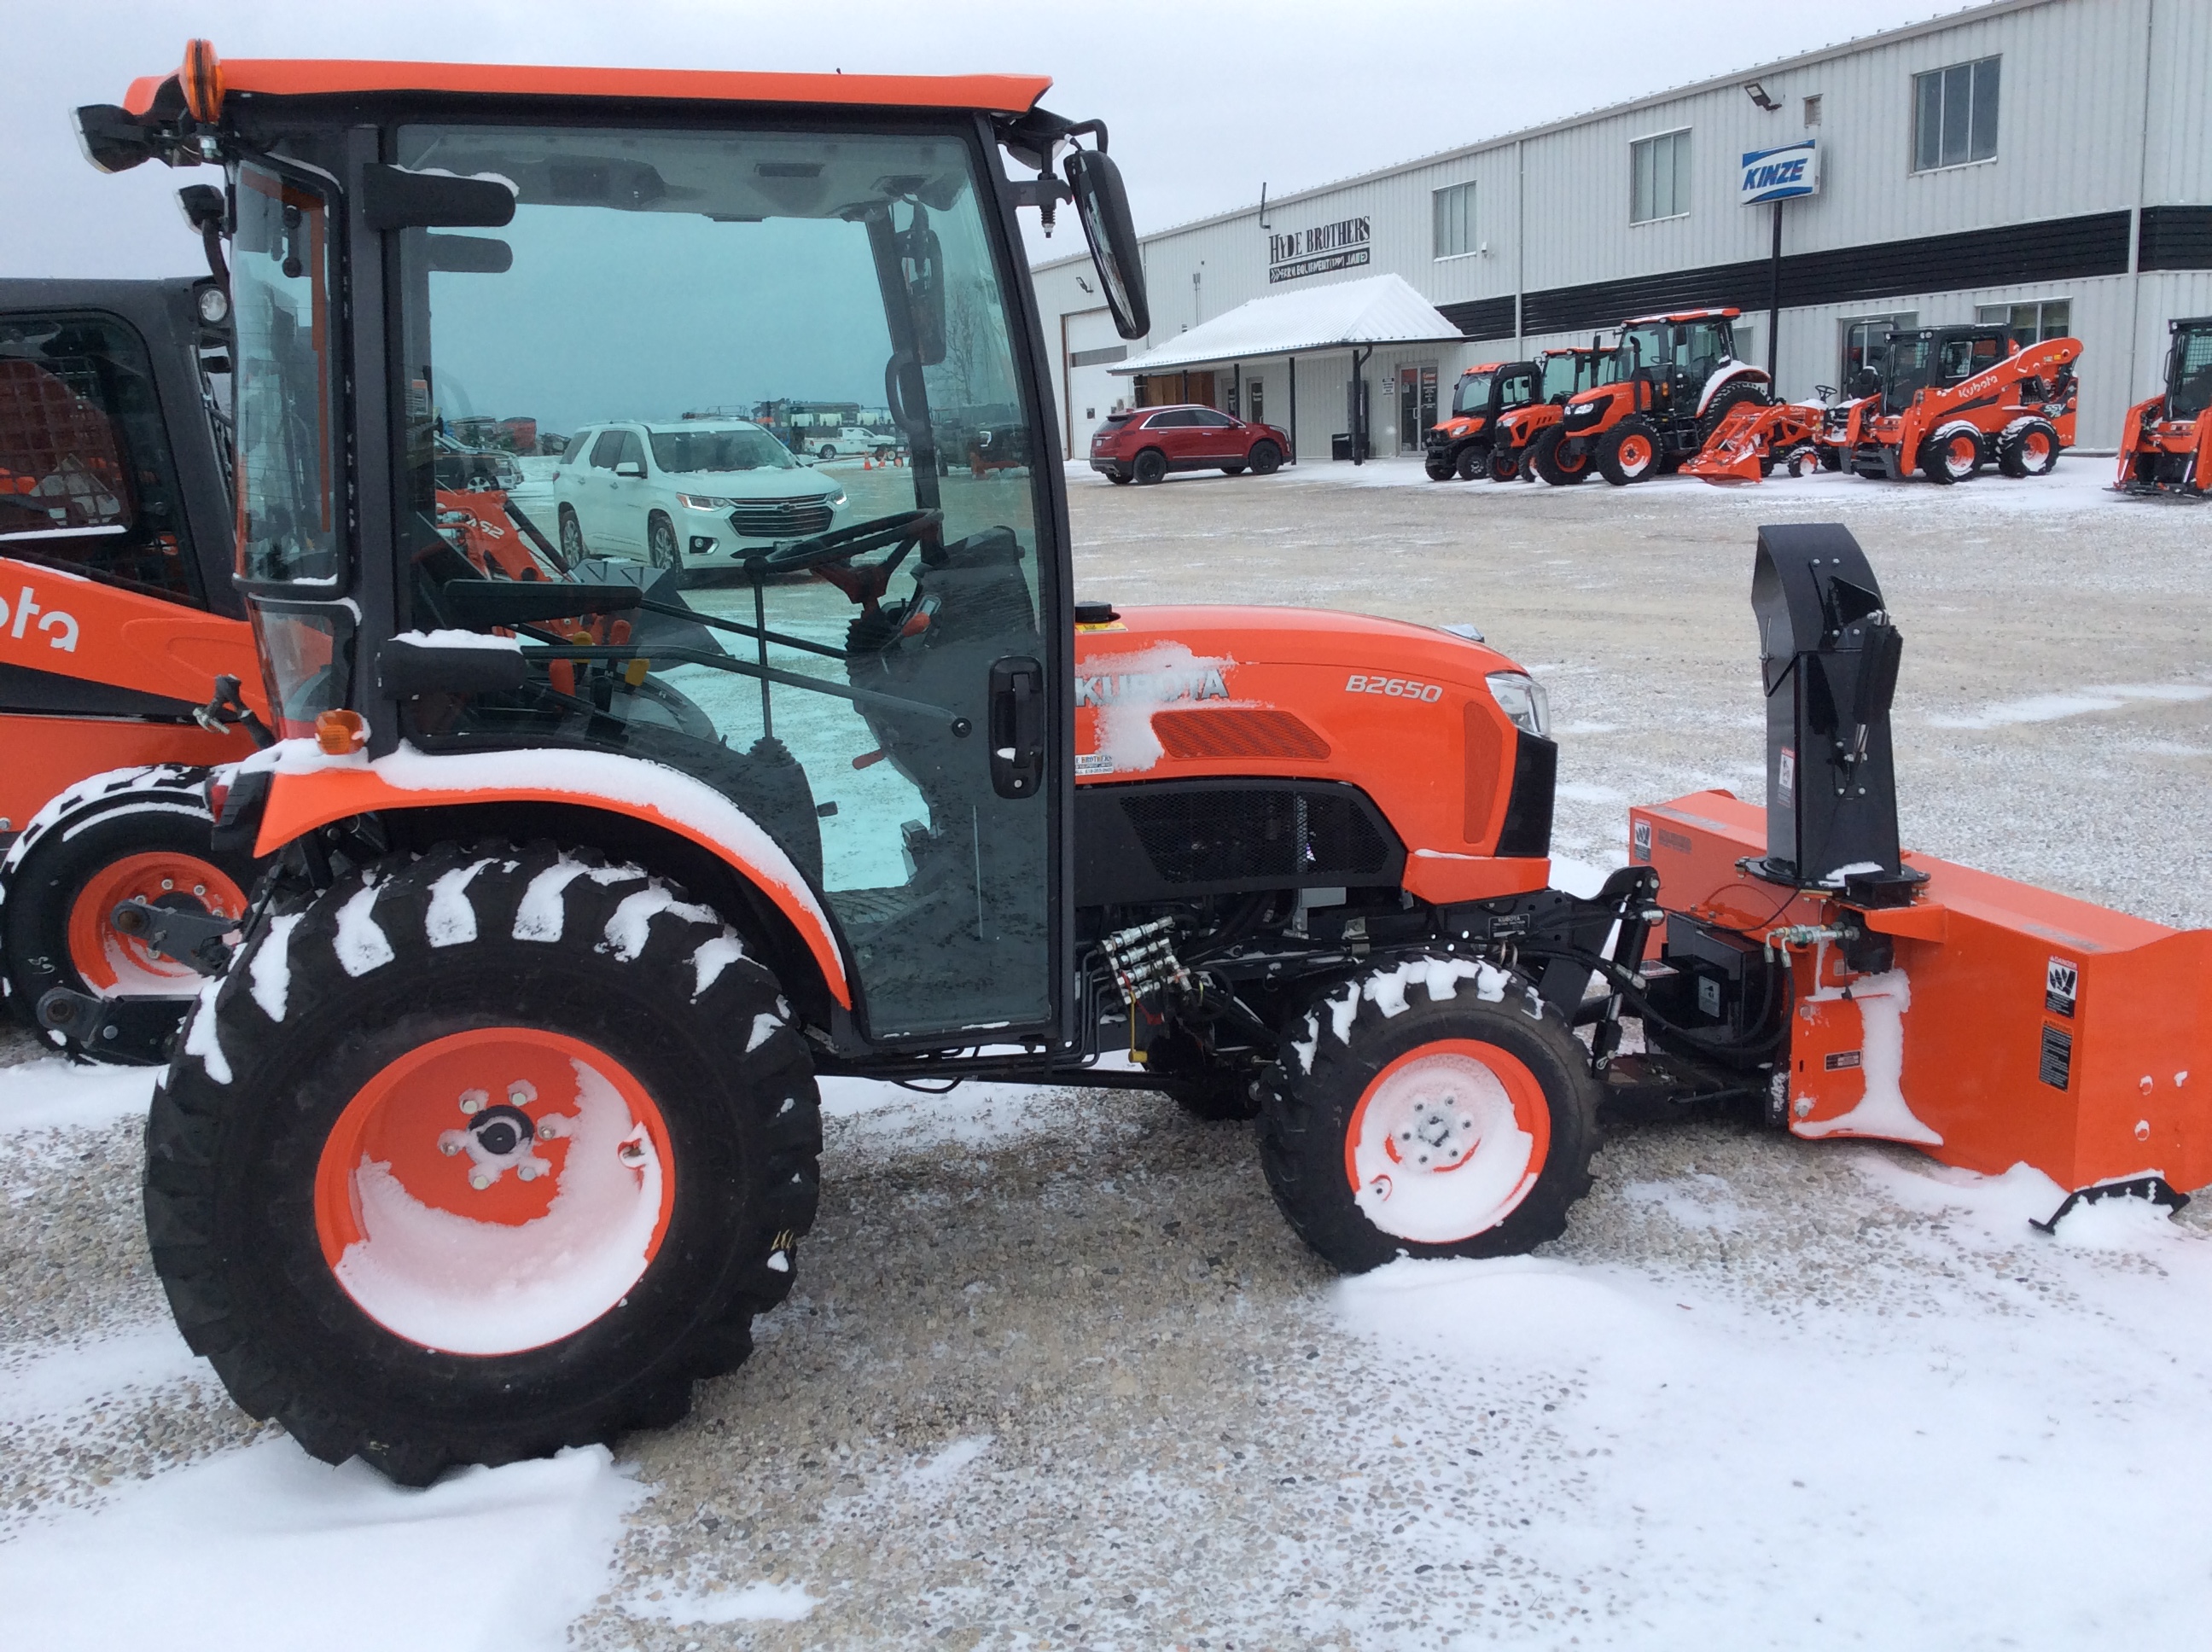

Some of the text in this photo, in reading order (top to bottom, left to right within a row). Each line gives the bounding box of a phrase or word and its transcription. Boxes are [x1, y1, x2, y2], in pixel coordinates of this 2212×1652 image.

[1742, 158, 1808, 191] KINZE
[1269, 216, 1371, 265] HYDE BROTHERS
[1958, 375, 1999, 398] Kubota
[2044, 403, 2067, 413] SSV
[0, 585, 80, 653] ta
[1074, 670, 1230, 707] KUTA
[1345, 674, 1443, 703] B2650
